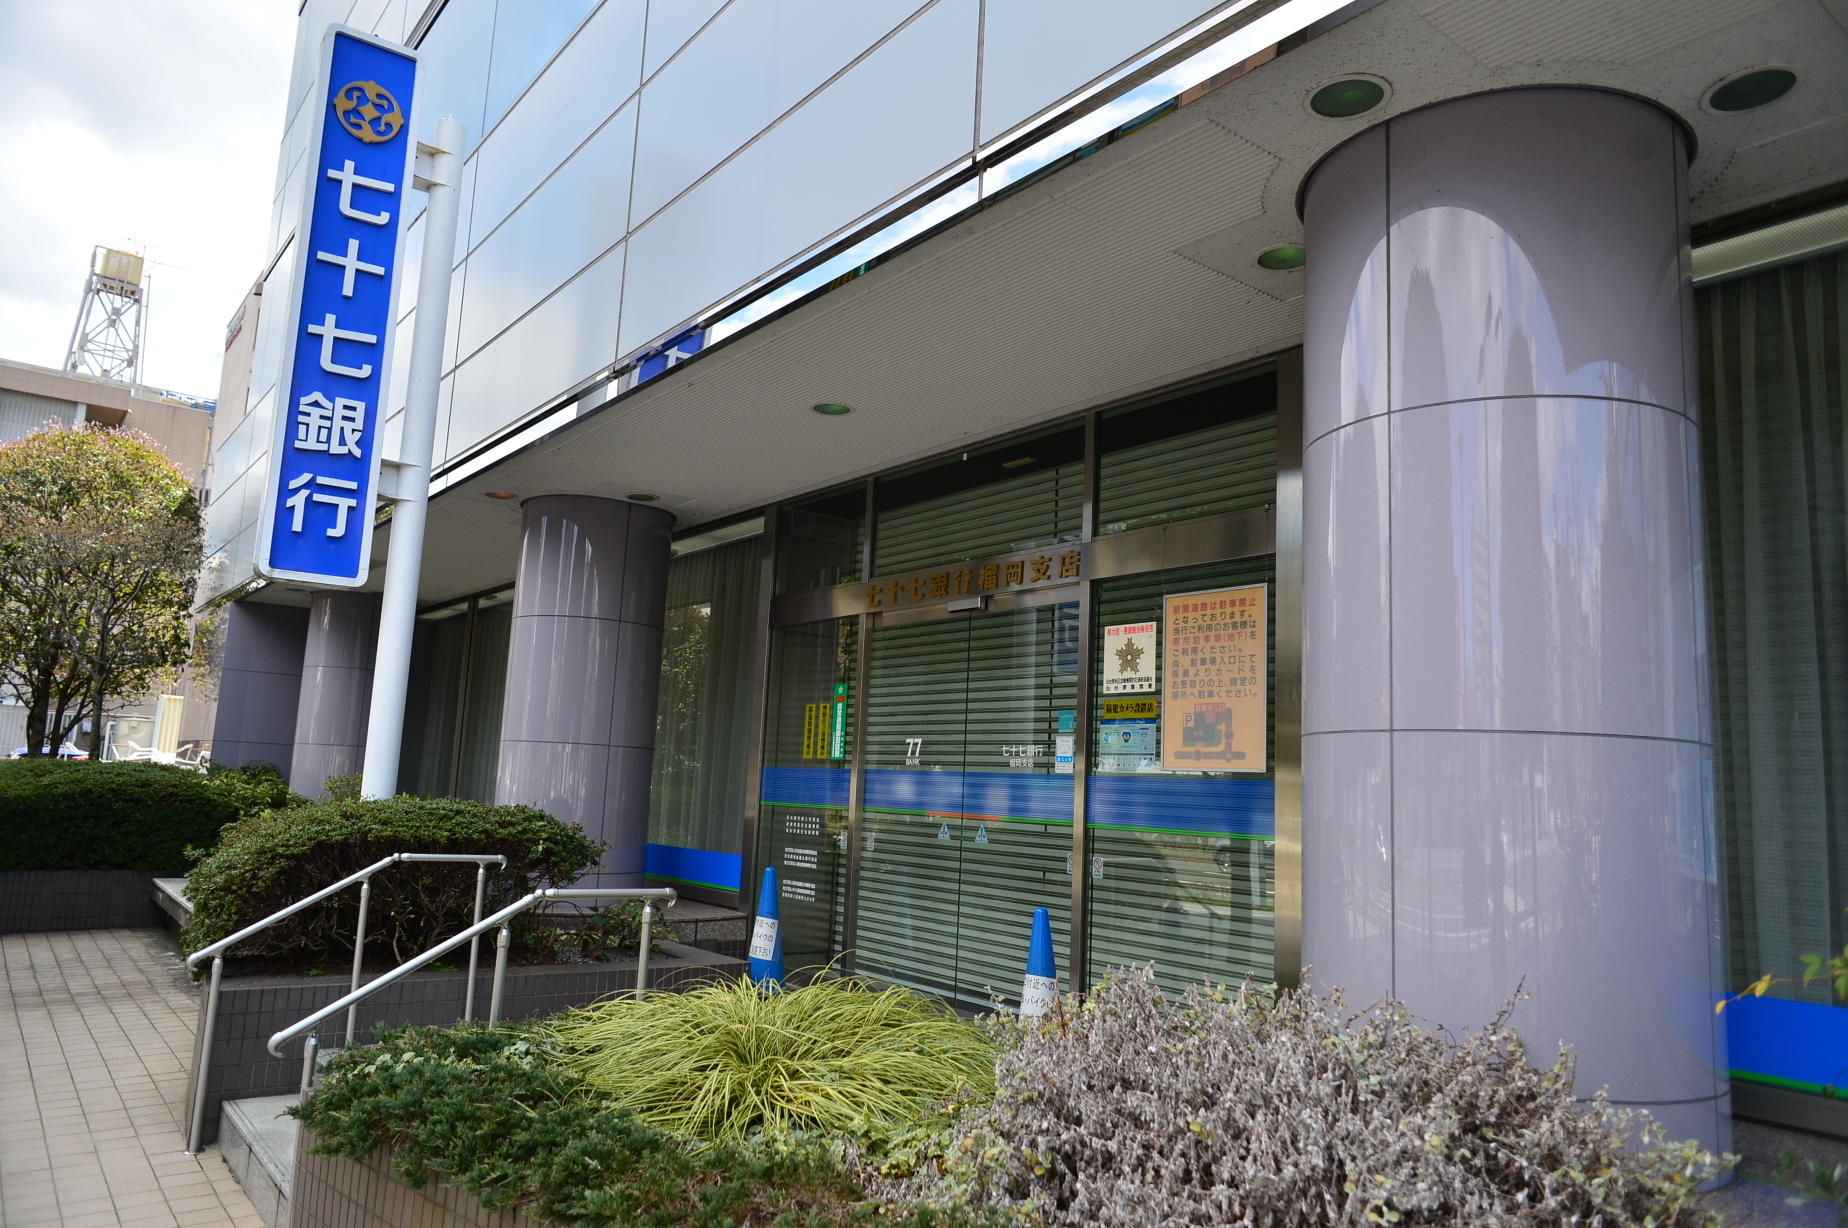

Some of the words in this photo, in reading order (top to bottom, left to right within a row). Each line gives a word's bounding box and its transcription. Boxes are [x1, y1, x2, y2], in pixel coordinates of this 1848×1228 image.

[286, 159, 395, 538] 七十七銀行
[1173, 609, 1252, 625] となっております。
[1173, 620, 1256, 635] 当行ご利用のお客様は
[1172, 646, 1242, 657] ご利用ください。
[1185, 715, 1192, 726] P
[906, 738, 922, 757] 77
[1002, 744, 1043, 757] 七十七銀行
[905, 758, 920, 766] BANK
